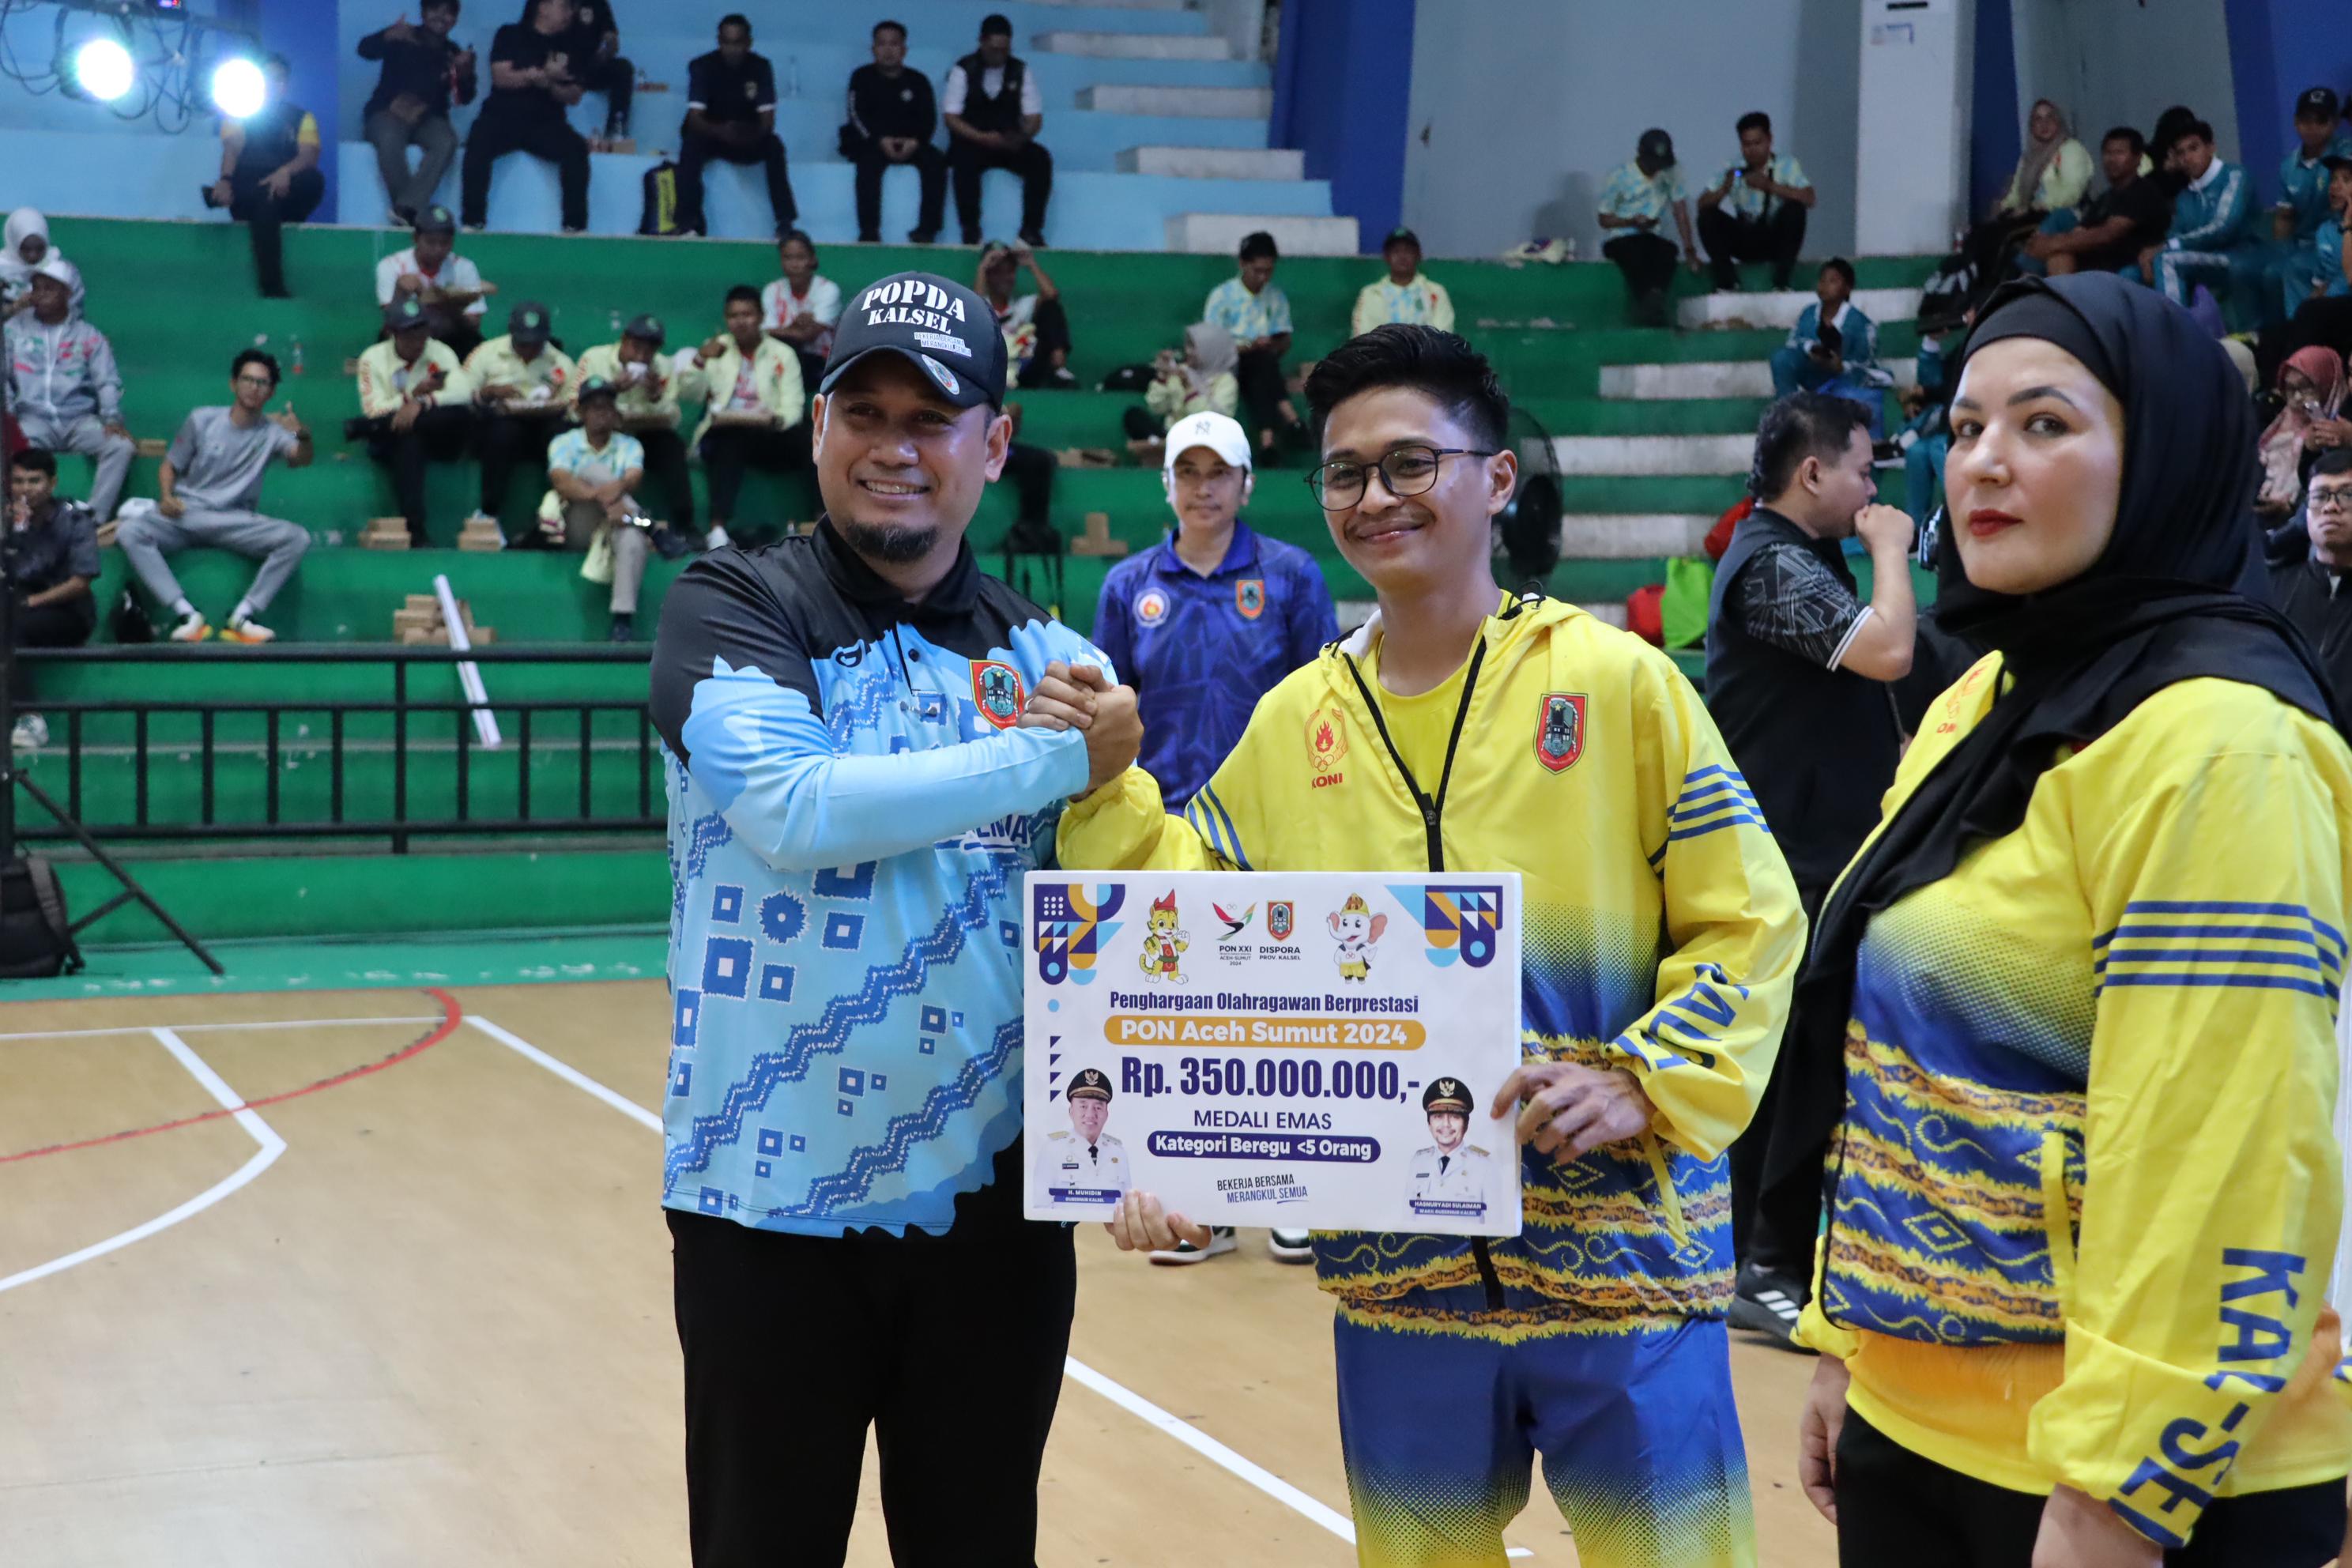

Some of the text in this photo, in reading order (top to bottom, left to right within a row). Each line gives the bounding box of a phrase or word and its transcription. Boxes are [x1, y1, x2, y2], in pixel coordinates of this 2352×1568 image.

[861, 280, 965, 322] POPDA
[868, 307, 951, 334] KALSEL
[1110, 991, 1419, 1013] Penghargaan Olahragawan Berprestasi
[1121, 1019, 1408, 1045] PON Aceh Sumut 2024
[1121, 1056, 1420, 1104] Rp. 350.000.000,-
[1194, 1110, 1332, 1130] MEDALI EMAS
[1155, 1135, 1372, 1160] Kategori Beregu <5 Orang
[1217, 1174, 1295, 1191] BEKERJA BERSAMA
[1227, 1185, 1308, 1204] MERANGKUL SEMUA
